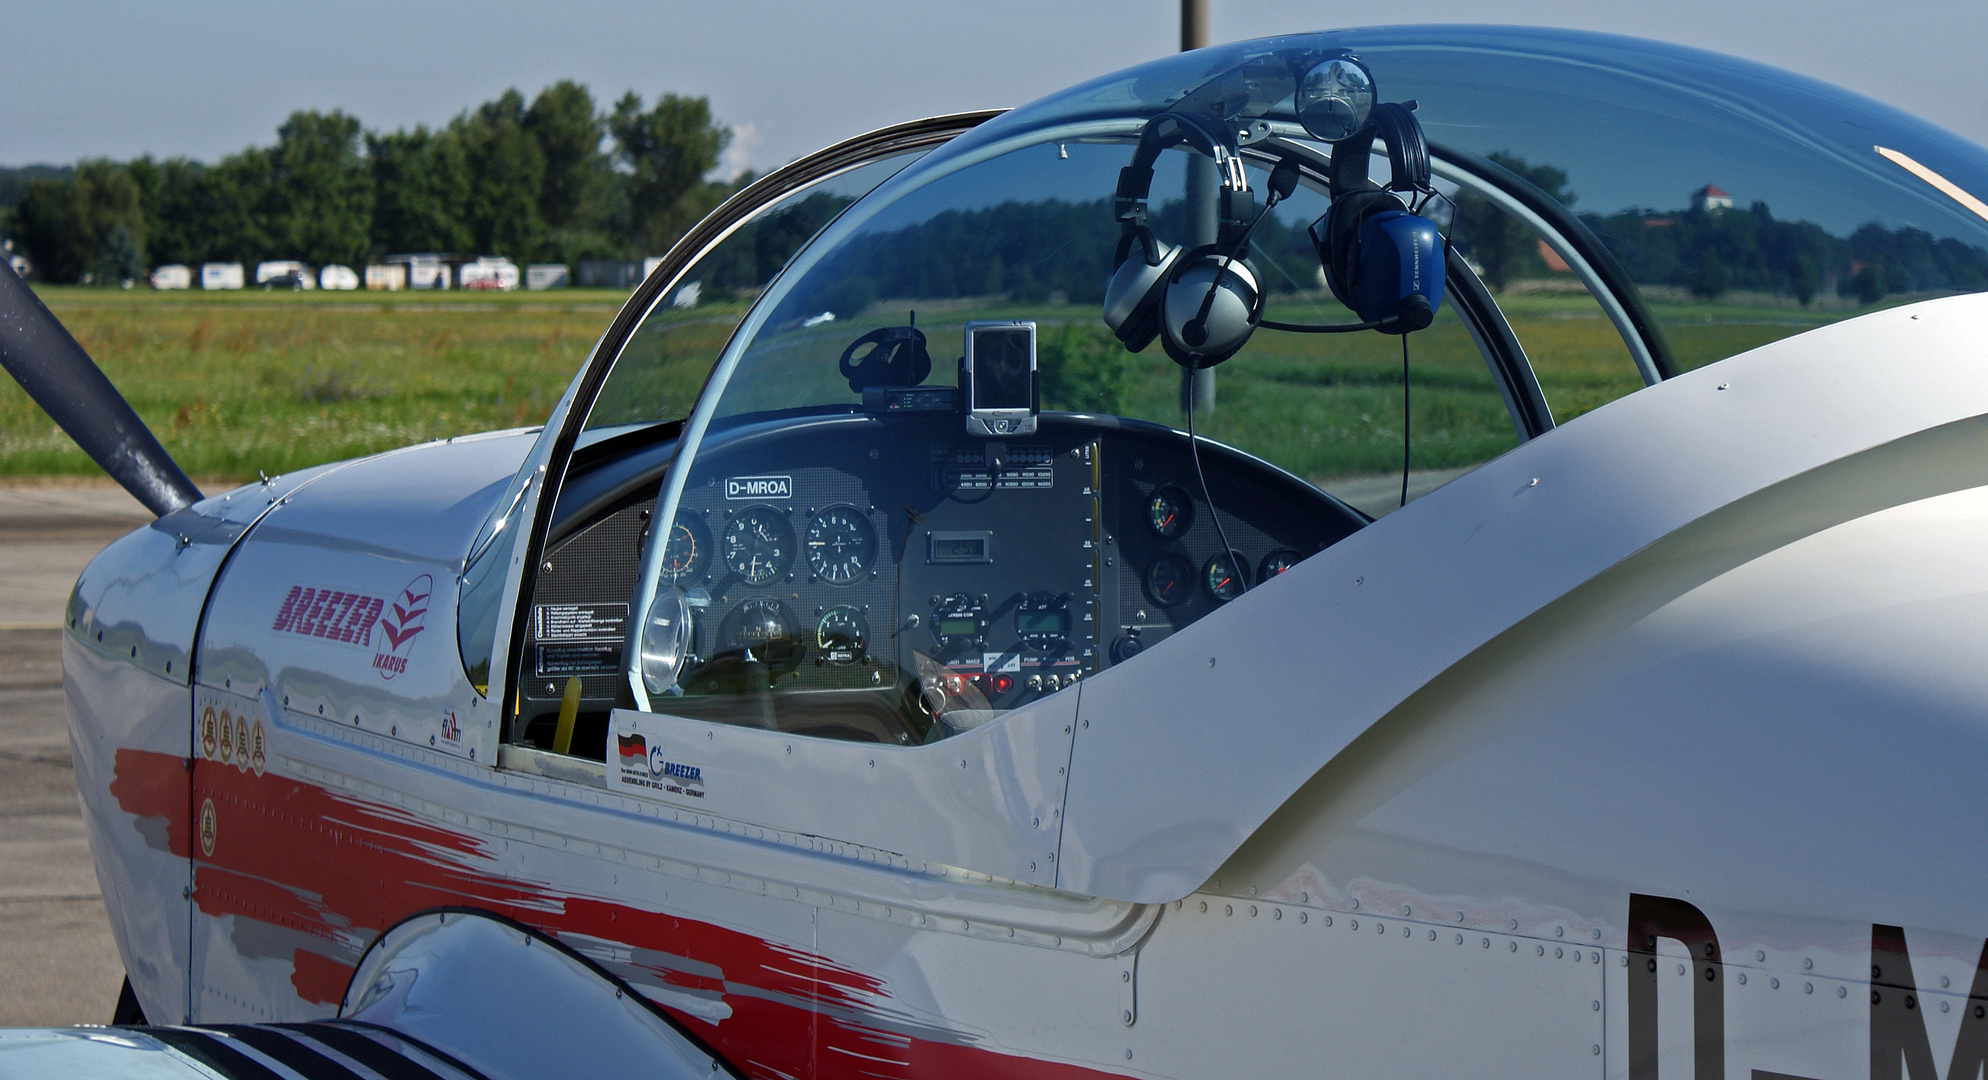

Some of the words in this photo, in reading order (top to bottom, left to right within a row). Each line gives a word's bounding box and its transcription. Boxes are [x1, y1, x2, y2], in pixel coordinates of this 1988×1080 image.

[1412, 231, 1420, 279] SENNHEISER
[729, 480, 788, 495] D-MROA
[738, 522, 745, 531] 9
[730, 535, 737, 544] 8
[729, 551, 736, 560] 7
[773, 548, 780, 557] 3
[739, 562, 745, 571] 6
[272, 585, 384, 647] BREEZER
[372, 653, 408, 674] IKARUS
[664, 761, 701, 781] BREEZER
